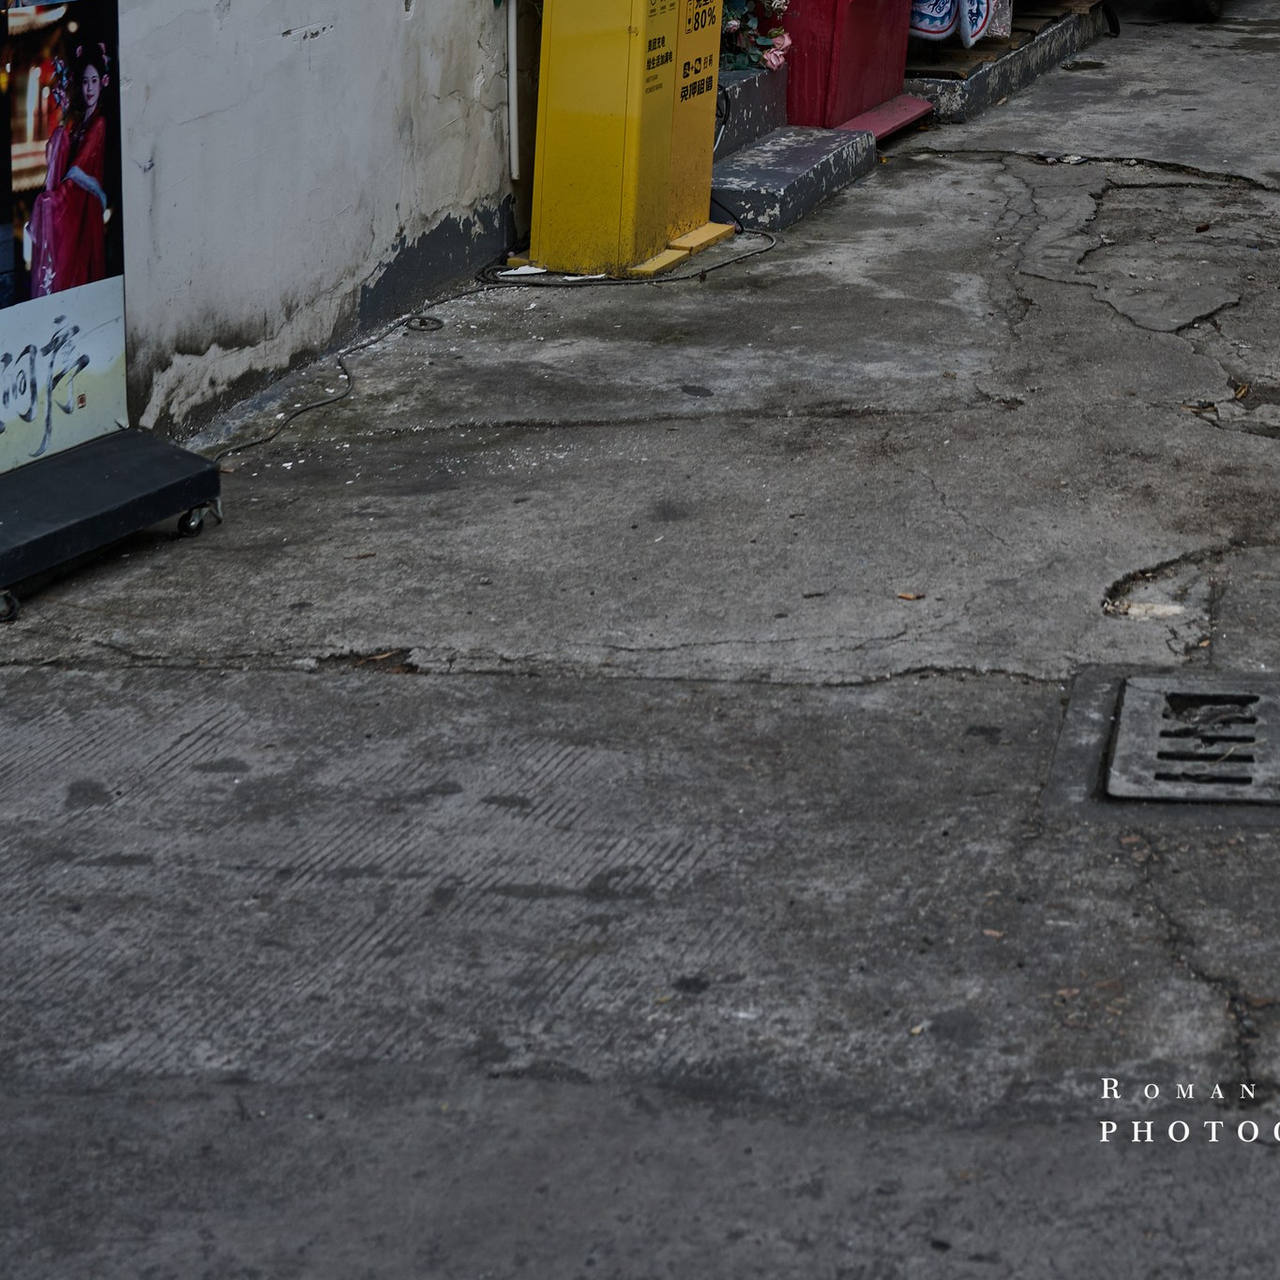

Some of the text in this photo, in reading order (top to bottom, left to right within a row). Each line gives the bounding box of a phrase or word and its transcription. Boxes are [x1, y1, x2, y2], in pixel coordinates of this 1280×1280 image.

[693, 6, 716, 31] 80%
[680, 75, 714, 102] 免押租借
